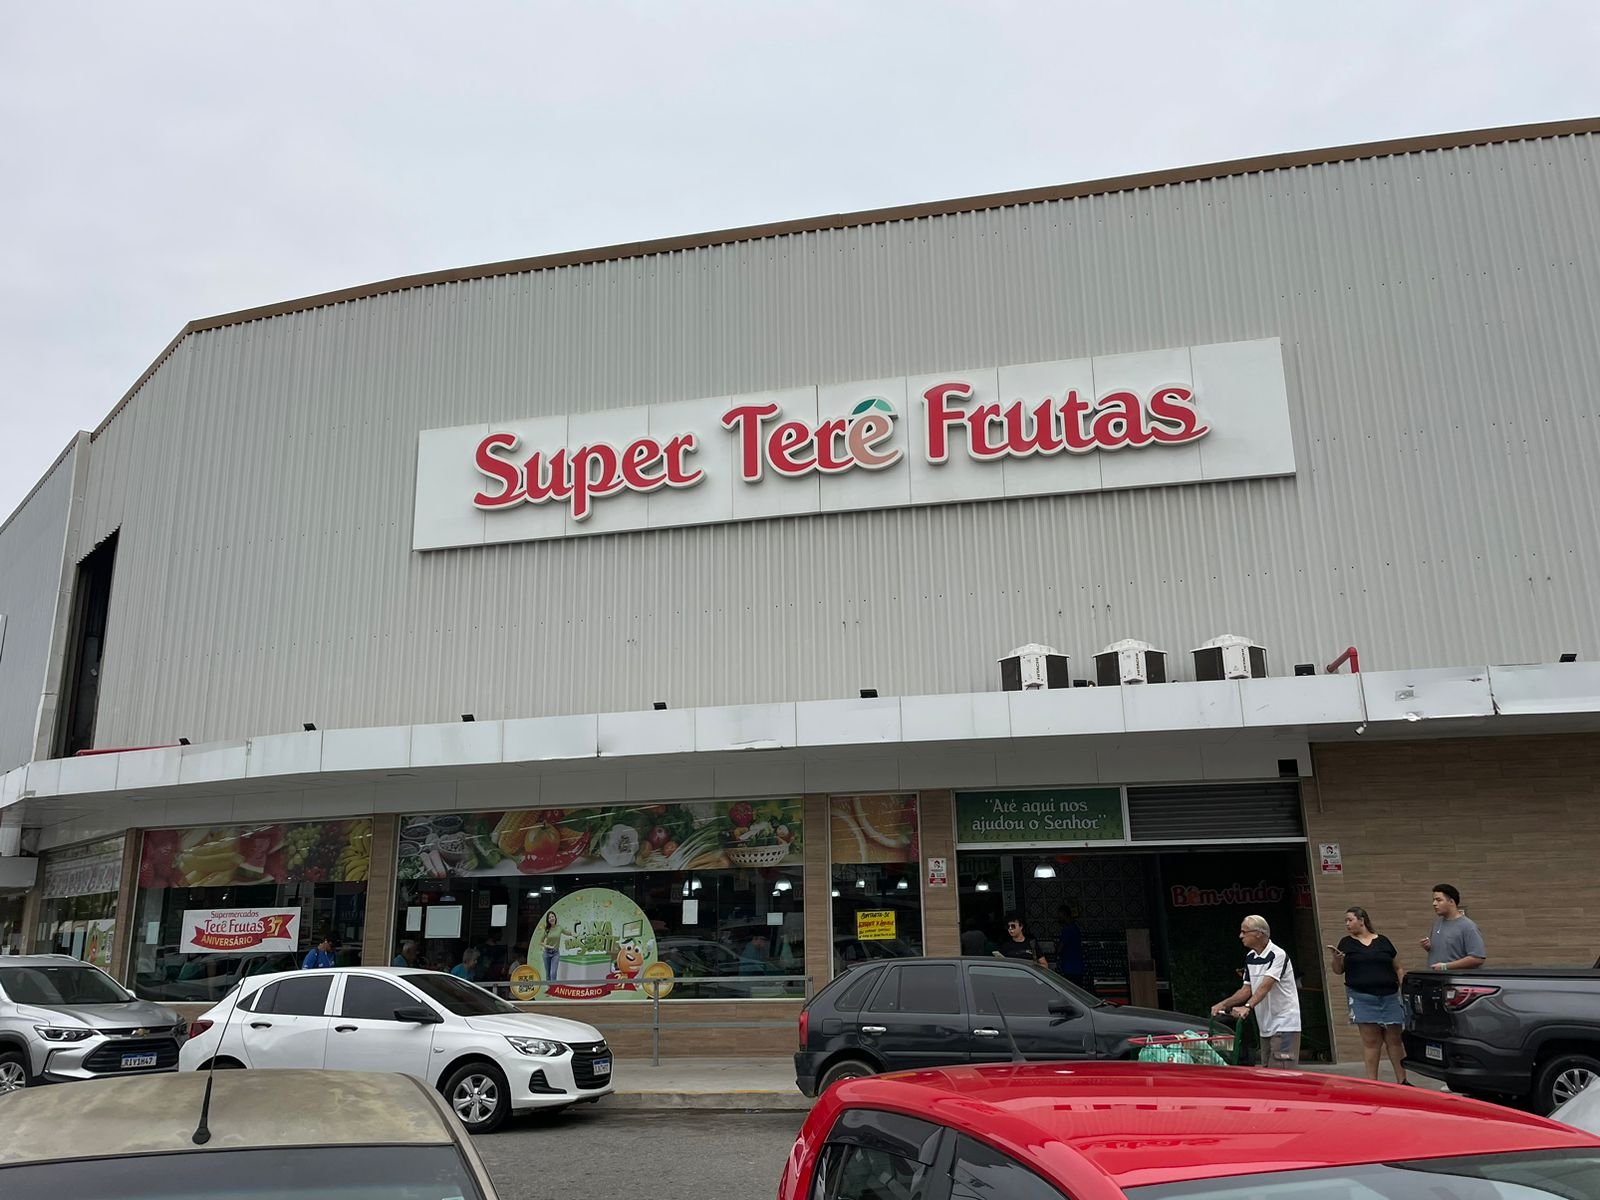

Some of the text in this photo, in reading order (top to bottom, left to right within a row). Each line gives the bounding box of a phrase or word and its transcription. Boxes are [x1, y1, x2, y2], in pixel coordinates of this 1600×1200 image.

[473, 383, 1211, 520] Super Terê Frutas
[1022, 798, 1056, 816] aqui
[1060, 800, 1088, 812] nos
[972, 816, 1025, 833] ajudou
[1028, 819, 1040, 830] o
[211, 910, 259, 919] Supermercados
[204, 919, 264, 933] Terê Frutas
[267, 916, 283, 936] 37
[201, 935, 253, 946] ANIVERSÁRIO
[554, 986, 603, 997] ANIVERSÁRIO
